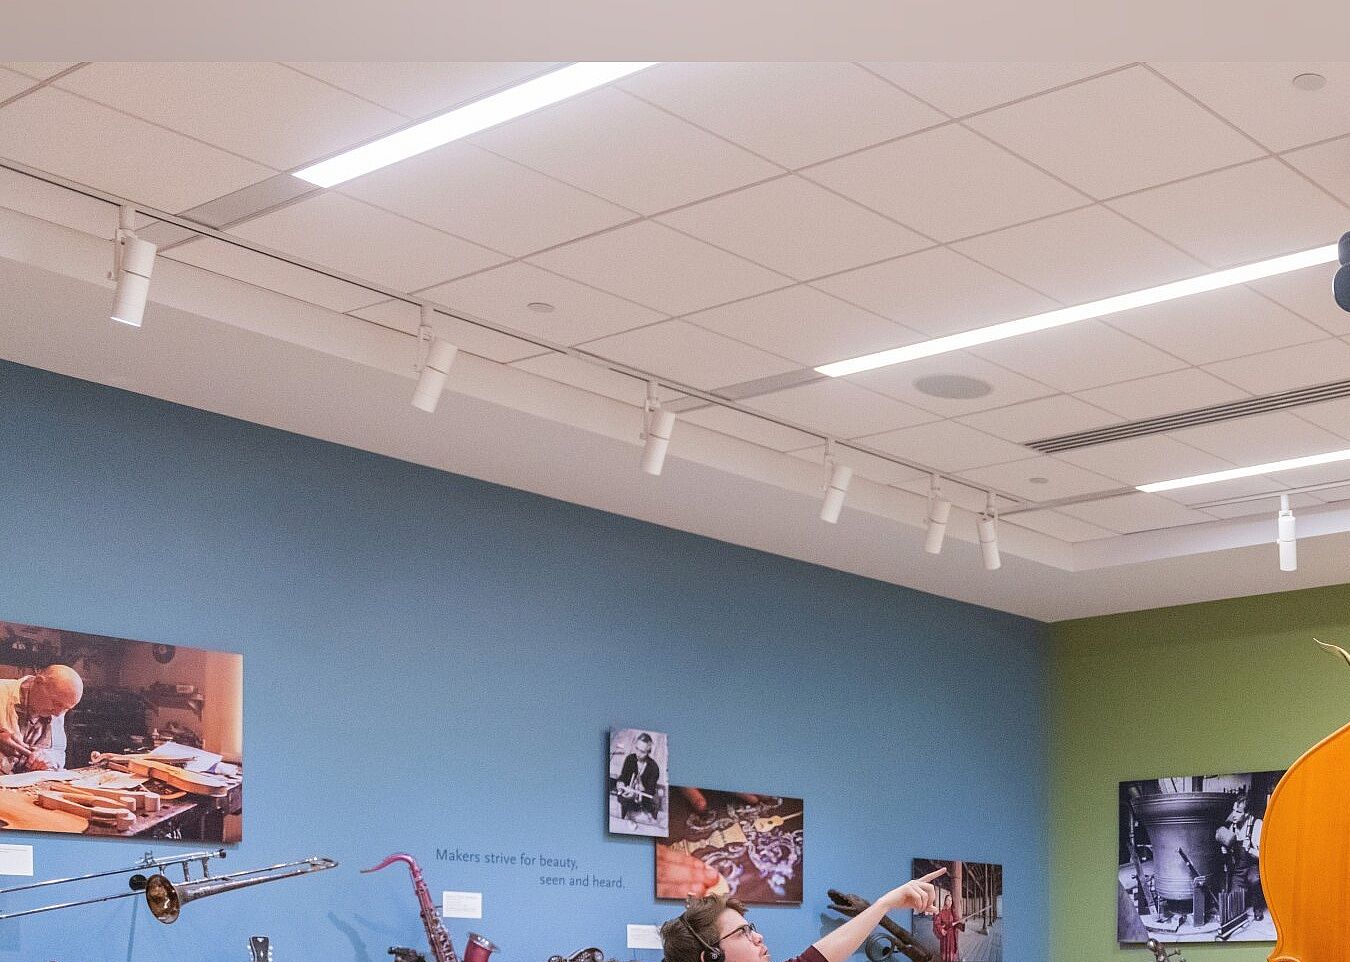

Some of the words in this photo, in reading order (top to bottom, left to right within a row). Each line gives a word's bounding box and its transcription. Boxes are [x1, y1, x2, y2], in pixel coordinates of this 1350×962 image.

[436, 849, 480, 863] Makers
[484, 854, 517, 865] strive
[520, 853, 537, 866] for
[539, 855, 578, 870] beauty,
[539, 874, 565, 885] seen
[569, 875, 589, 887] and
